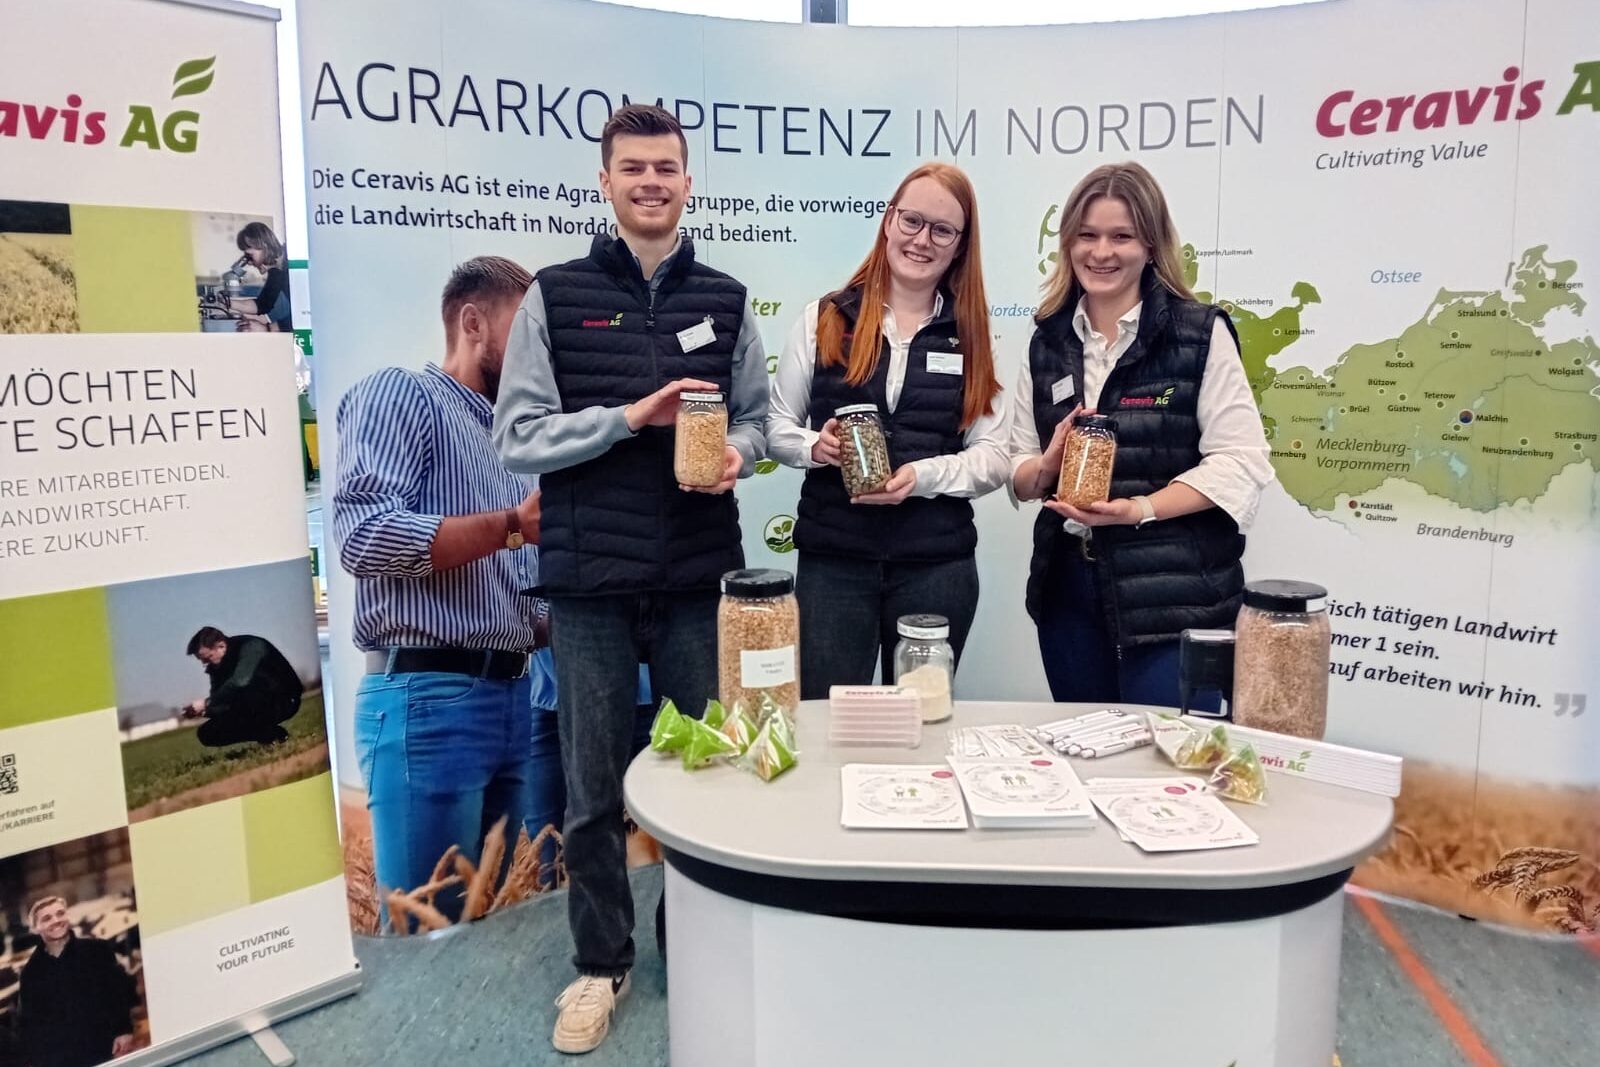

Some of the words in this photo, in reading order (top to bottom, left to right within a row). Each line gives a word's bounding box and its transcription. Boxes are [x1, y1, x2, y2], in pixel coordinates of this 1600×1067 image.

[311, 61, 892, 157] AGRARKOPETENZ
[915, 108, 977, 157] IM
[1006, 94, 1265, 155] NORDEN
[1315, 66, 1546, 139] Ceravis
[119, 104, 201, 154] AG
[1315, 146, 1426, 170] Cultivating
[1431, 140, 1489, 161] Value
[313, 168, 345, 189] Die
[351, 168, 435, 194] Ceravis
[440, 174, 470, 195] AG
[475, 177, 501, 198] ist
[507, 179, 551, 201] eine
[764, 193, 795, 214] die
[799, 196, 891, 219] vorwiege
[314, 204, 345, 226] die
[351, 204, 518, 232] Landwirtschaft
[522, 212, 542, 234] in
[719, 222, 798, 243] bedient.
[1370, 269, 1423, 284] Ostsee
[1551, 281, 1584, 290] Bergen
[1235, 297, 1274, 307] Schönberg
[1457, 309, 1497, 318] Stralsund
[1284, 327, 1316, 336] Lensahn
[1440, 341, 1472, 350] Semlow
[1385, 360, 1415, 369] Rostock
[1548, 367, 1585, 377] Wolgast
[1273, 382, 1327, 390] Grevesmühlen
[1367, 378, 1397, 387] Bützow
[1154, 396, 1170, 405] AG
[1423, 391, 1456, 400] Teterow
[1349, 405, 1370, 413] Brüel
[1387, 404, 1422, 414] Güstrow
[1475, 413, 1509, 423] Malchin
[55, 407, 267, 451] SCHAFFEN
[1554, 431, 1598, 442] Strasburg
[1315, 438, 1412, 457] Mecklenburg-
[1482, 445, 1554, 460] Neubrandenburg
[1316, 456, 1411, 473] Vorpommern
[38, 463, 231, 494] MITARBEITENDEN.
[0, 493, 190, 528] ANDWIRTSCHAFT.
[1360, 501, 1393, 511] Karstädt
[44, 525, 149, 553] ZUKUNFT.
[1416, 522, 1515, 549] Brandenburg
[1372, 605, 1449, 632] tätigen
[1454, 614, 1559, 646] Landwirt
[1375, 635, 1387, 652] 1
[1393, 640, 1440, 660] sein.
[1363, 665, 1452, 693] arbeiten
[1458, 681, 1495, 701] wir
[1499, 685, 1542, 709] hin.
[219, 925, 290, 958] CULTIVATING
[216, 954, 249, 973] YOUR
[251, 938, 296, 962] FUTURE
